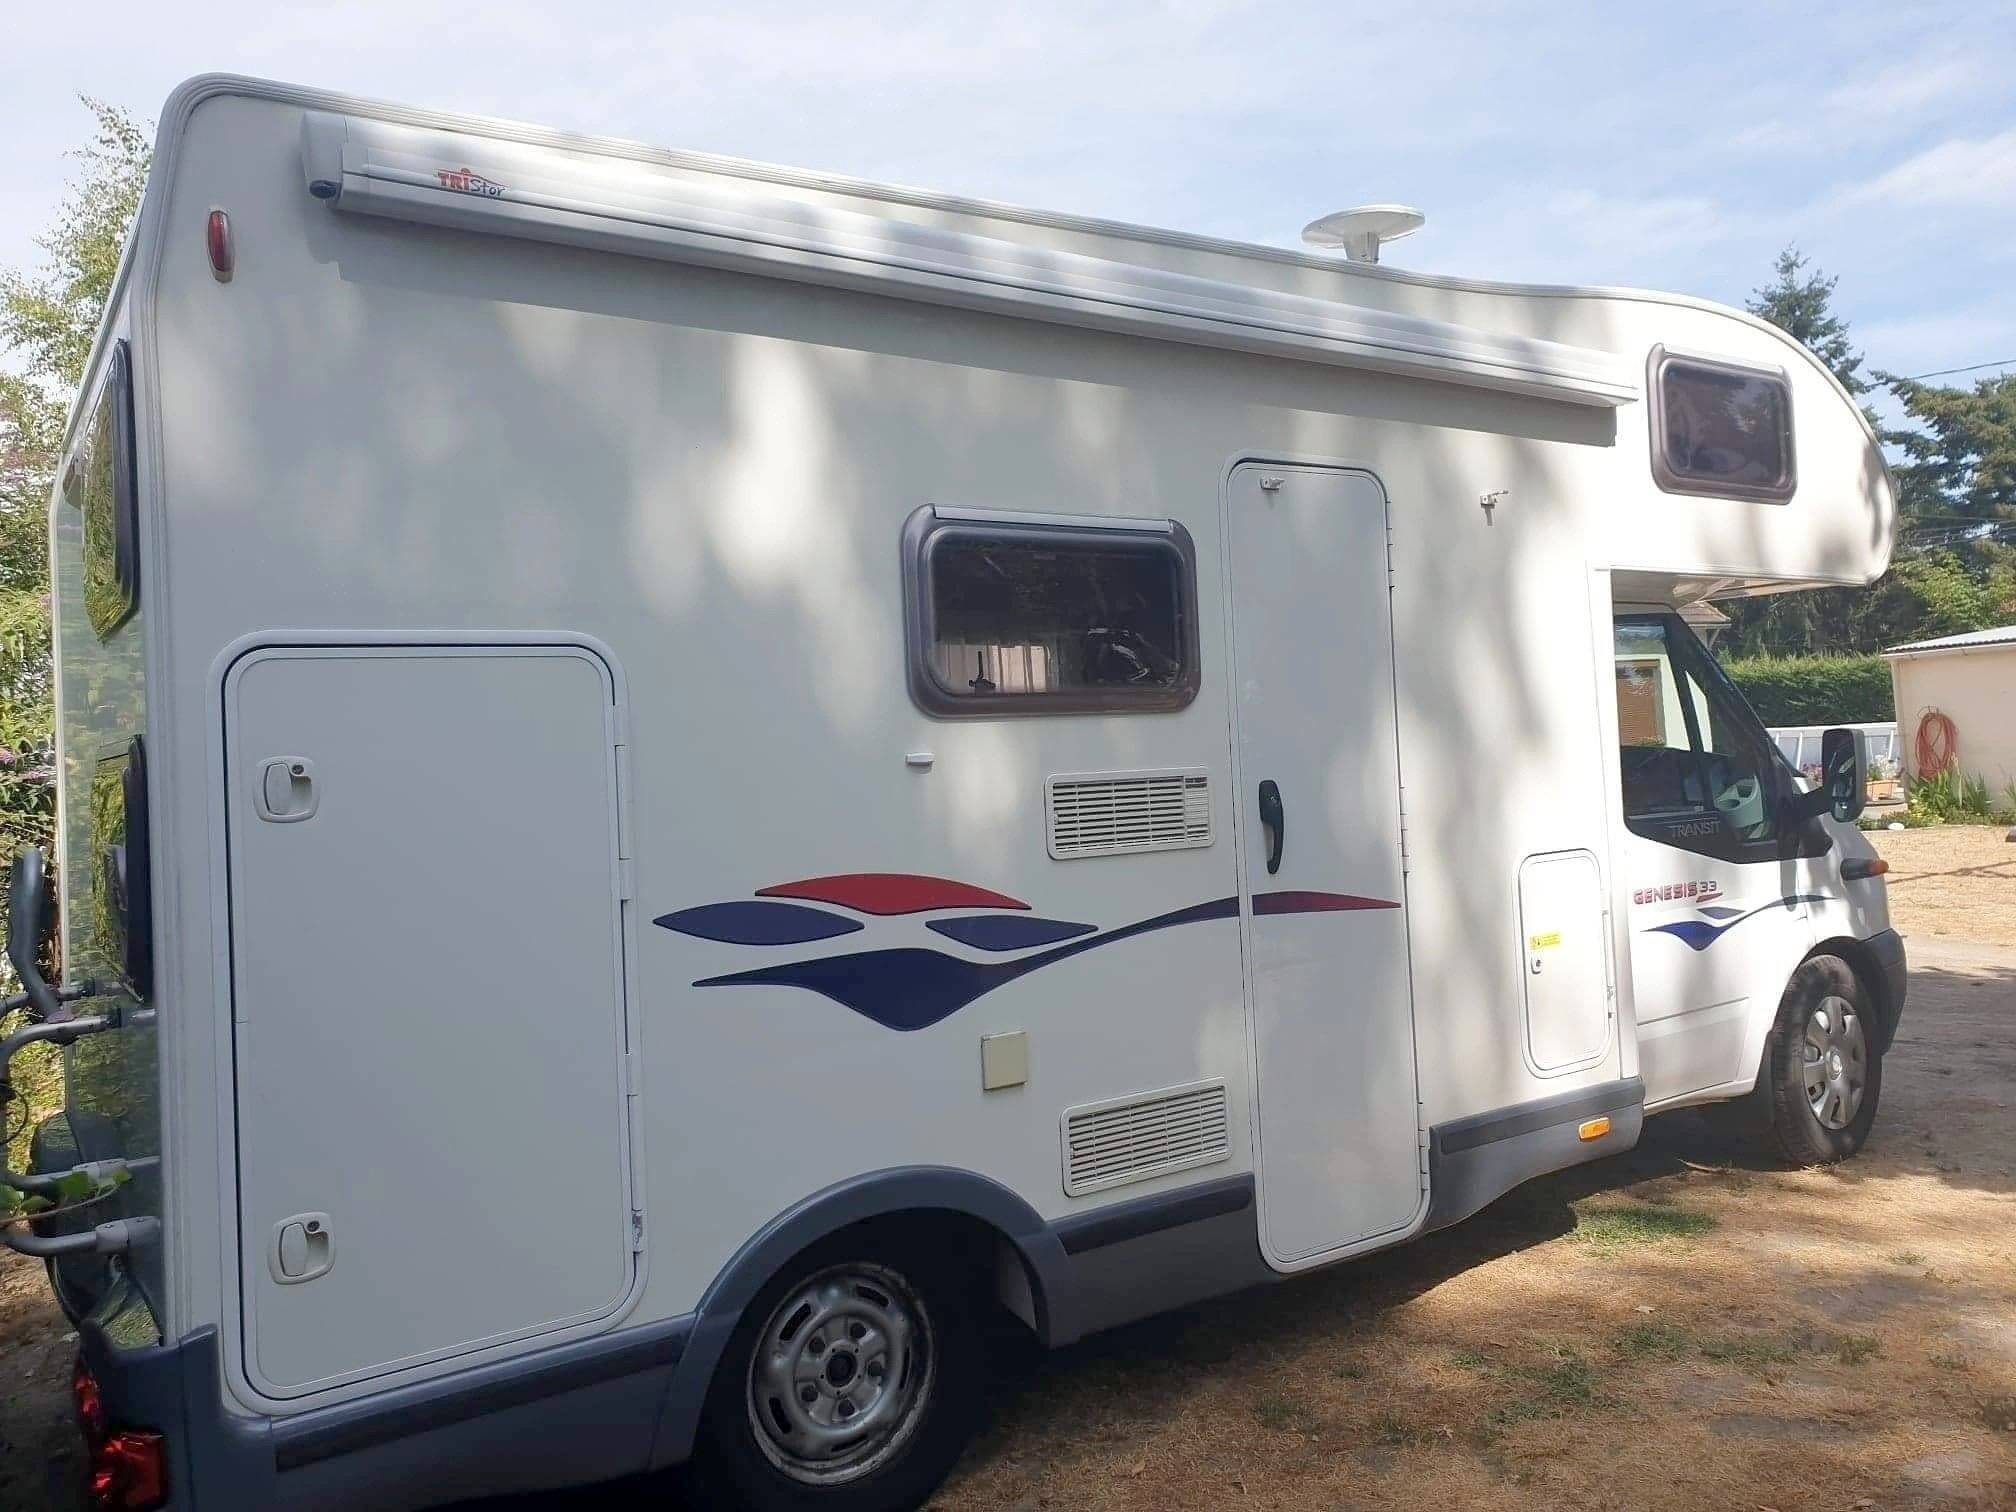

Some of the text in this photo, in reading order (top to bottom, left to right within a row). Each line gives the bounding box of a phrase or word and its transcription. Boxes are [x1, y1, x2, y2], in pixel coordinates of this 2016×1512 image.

[1671, 820, 1720, 839] TRANSIT
[1633, 880, 1717, 904] GENESIS 33
